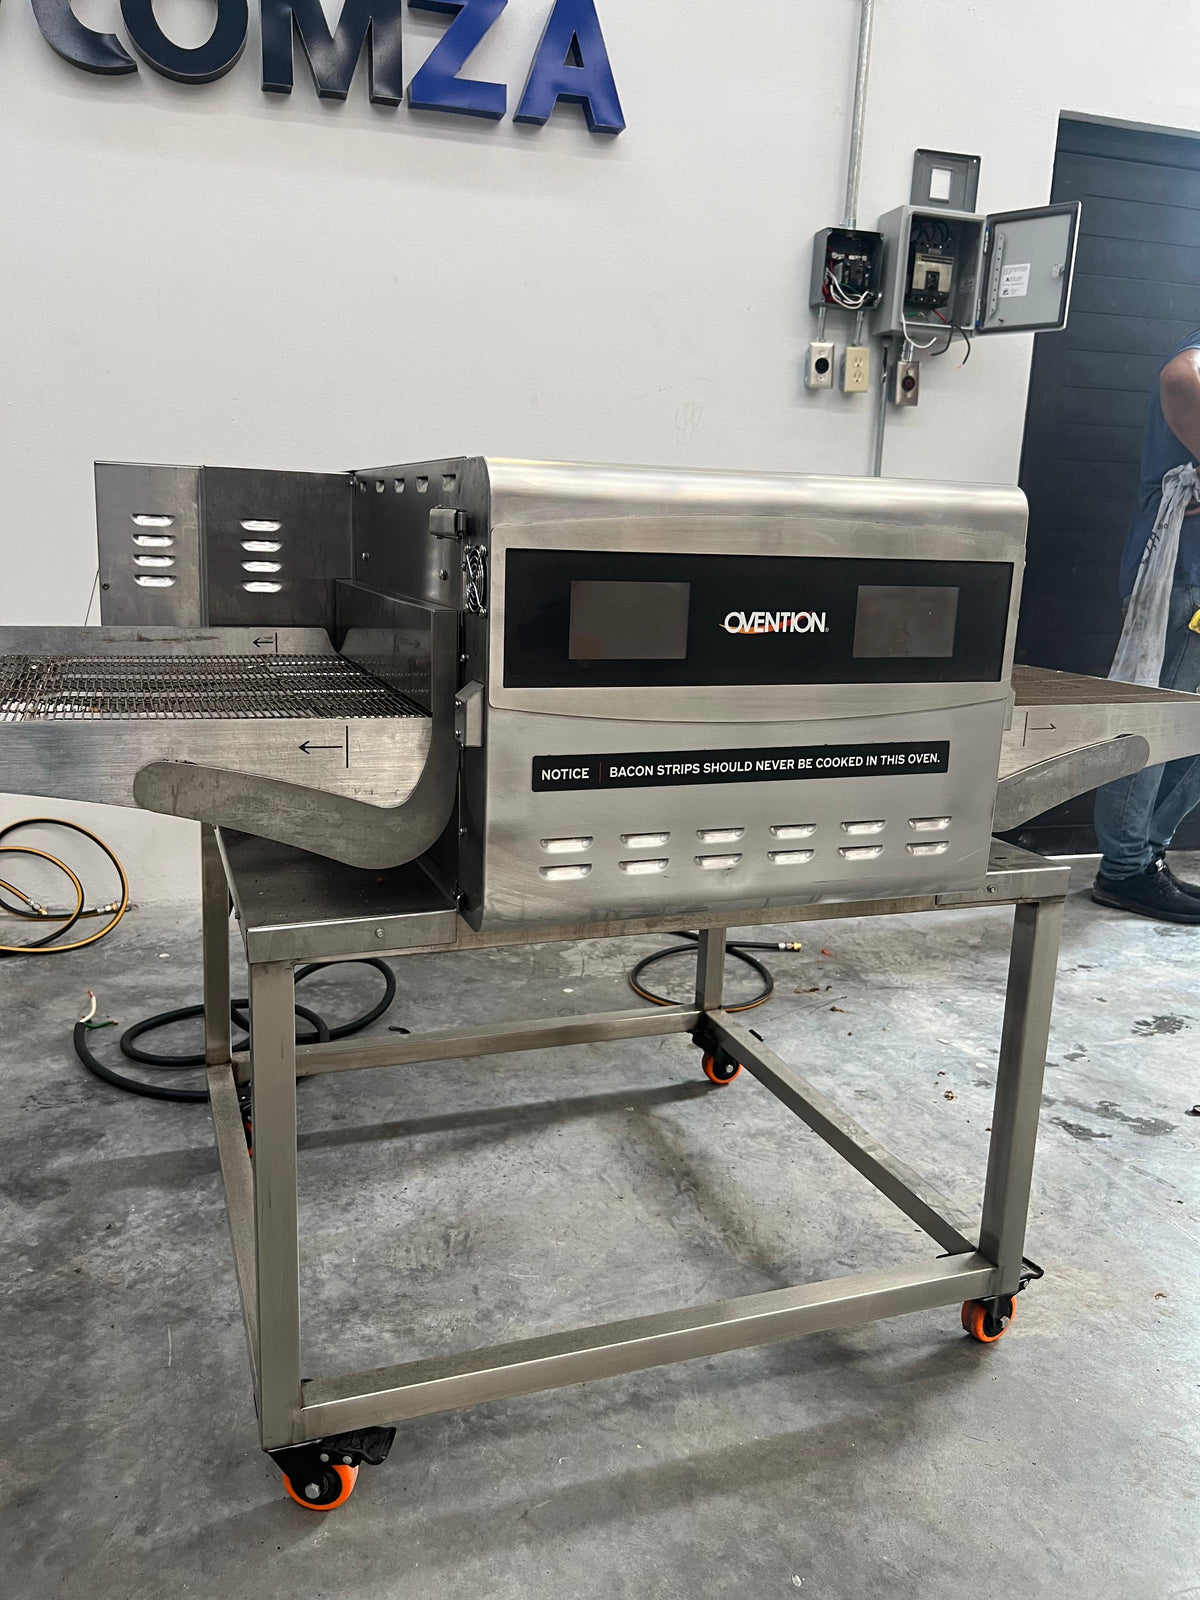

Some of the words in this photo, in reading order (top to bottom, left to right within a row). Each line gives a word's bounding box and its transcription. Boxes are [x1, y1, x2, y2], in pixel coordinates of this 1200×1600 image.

[723, 611, 827, 634] OVENTION
[541, 767, 590, 781] NOTICE
[609, 765, 654, 778] BACON
[656, 763, 701, 776] STRIPS
[703, 761, 753, 774] SHOULD
[755, 759, 795, 771] NEVER
[797, 758, 814, 769] BE
[815, 756, 864, 769] COOKED
[866, 755, 878, 766] IN
[880, 754, 906, 766] THIS
[907, 752, 941, 765] OVEN.
